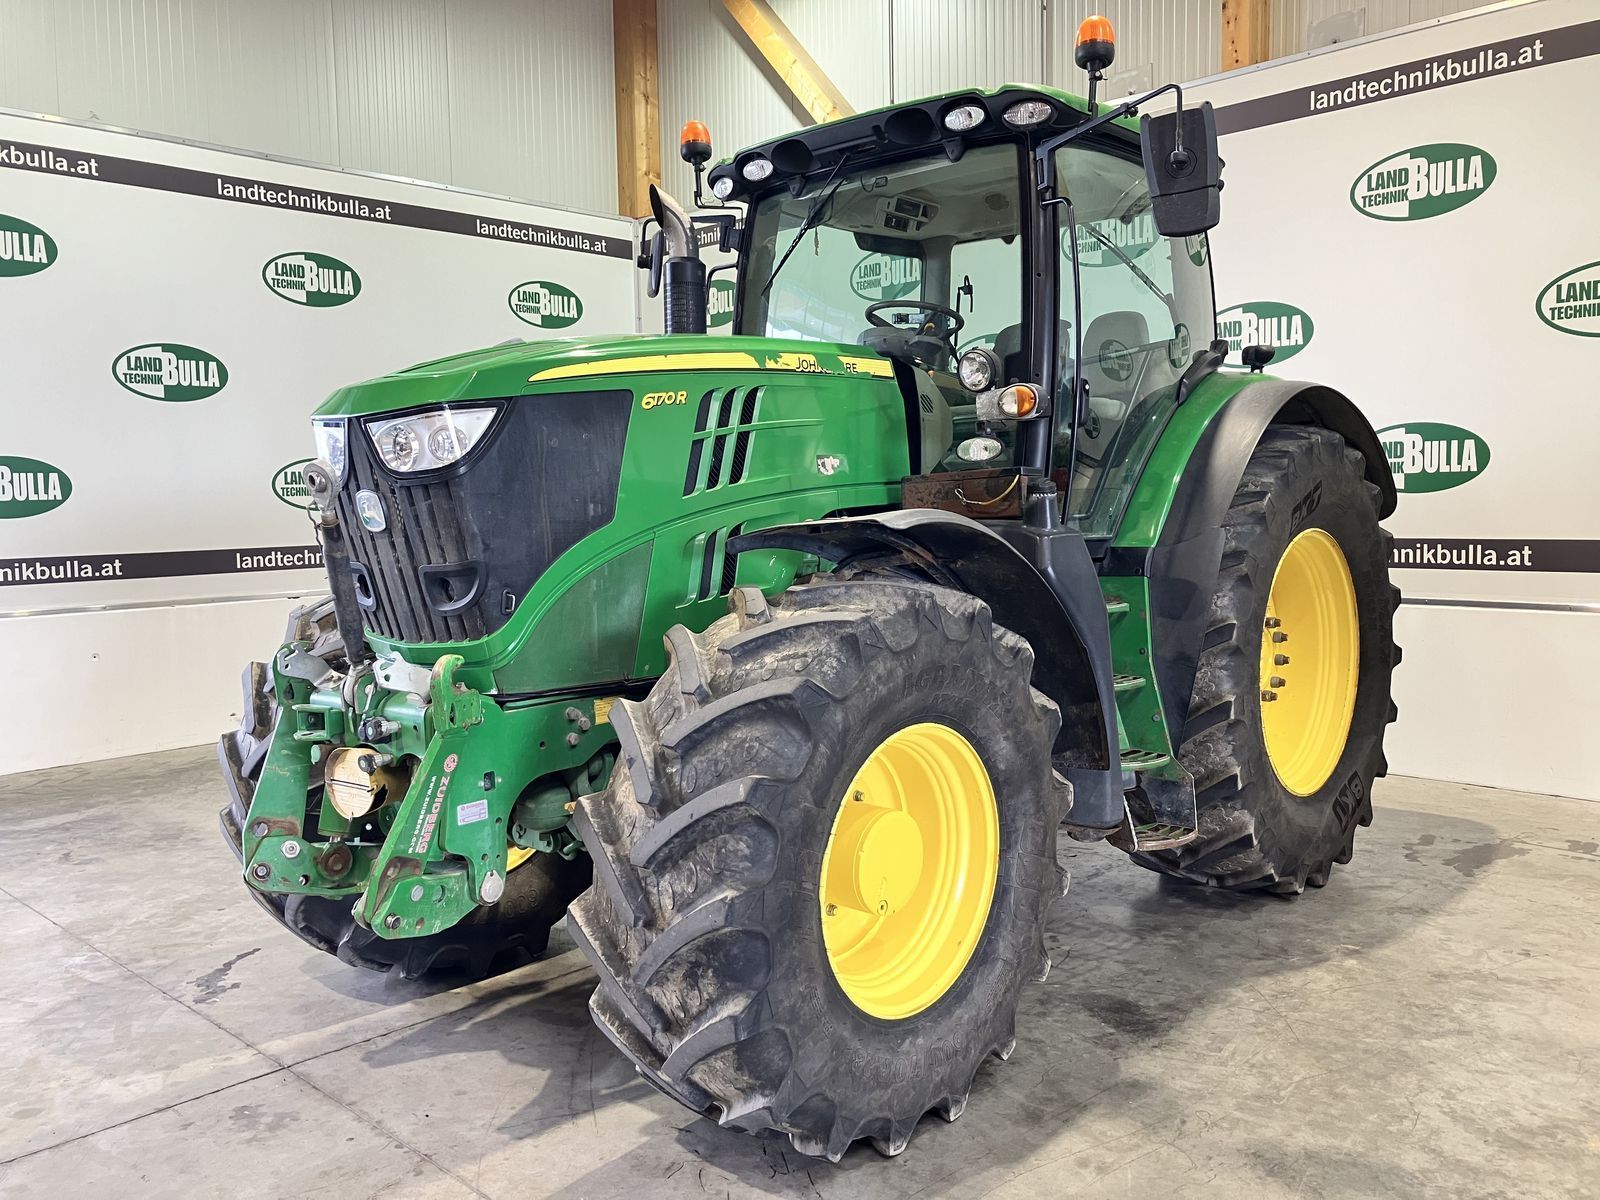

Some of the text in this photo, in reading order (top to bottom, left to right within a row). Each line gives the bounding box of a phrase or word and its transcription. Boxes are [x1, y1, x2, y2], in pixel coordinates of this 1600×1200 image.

[1310, 39, 1544, 111] landtechnikbulla.at
[1367, 167, 1409, 193] LAND
[1407, 154, 1484, 201] BULLA
[217, 178, 392, 221] landtechnikbulla.at
[1361, 188, 1409, 208] TECHNIK
[476, 218, 607, 253] landtechnikbulla.at
[274, 261, 306, 280] LAND
[304, 260, 355, 296] BULLA
[858, 262, 881, 280] LAND
[880, 255, 921, 288] BULLA
[271, 277, 306, 291] TECHNIK
[517, 289, 541, 304] LAND
[855, 278, 882, 291] TECHNIK
[514, 303, 541, 315] TECHNIK
[539, 287, 578, 319] BULLA
[1549, 302, 1600, 321] TECHNI
[1241, 312, 1304, 348] BULLA
[126, 355, 163, 373] LAND
[161, 351, 221, 388] BULLA
[122, 372, 164, 386] TECHNIK
[1403, 433, 1478, 474] BULLA
[280, 486, 312, 497] TECHNI
[417, 775, 451, 854] ZUIDBERG
